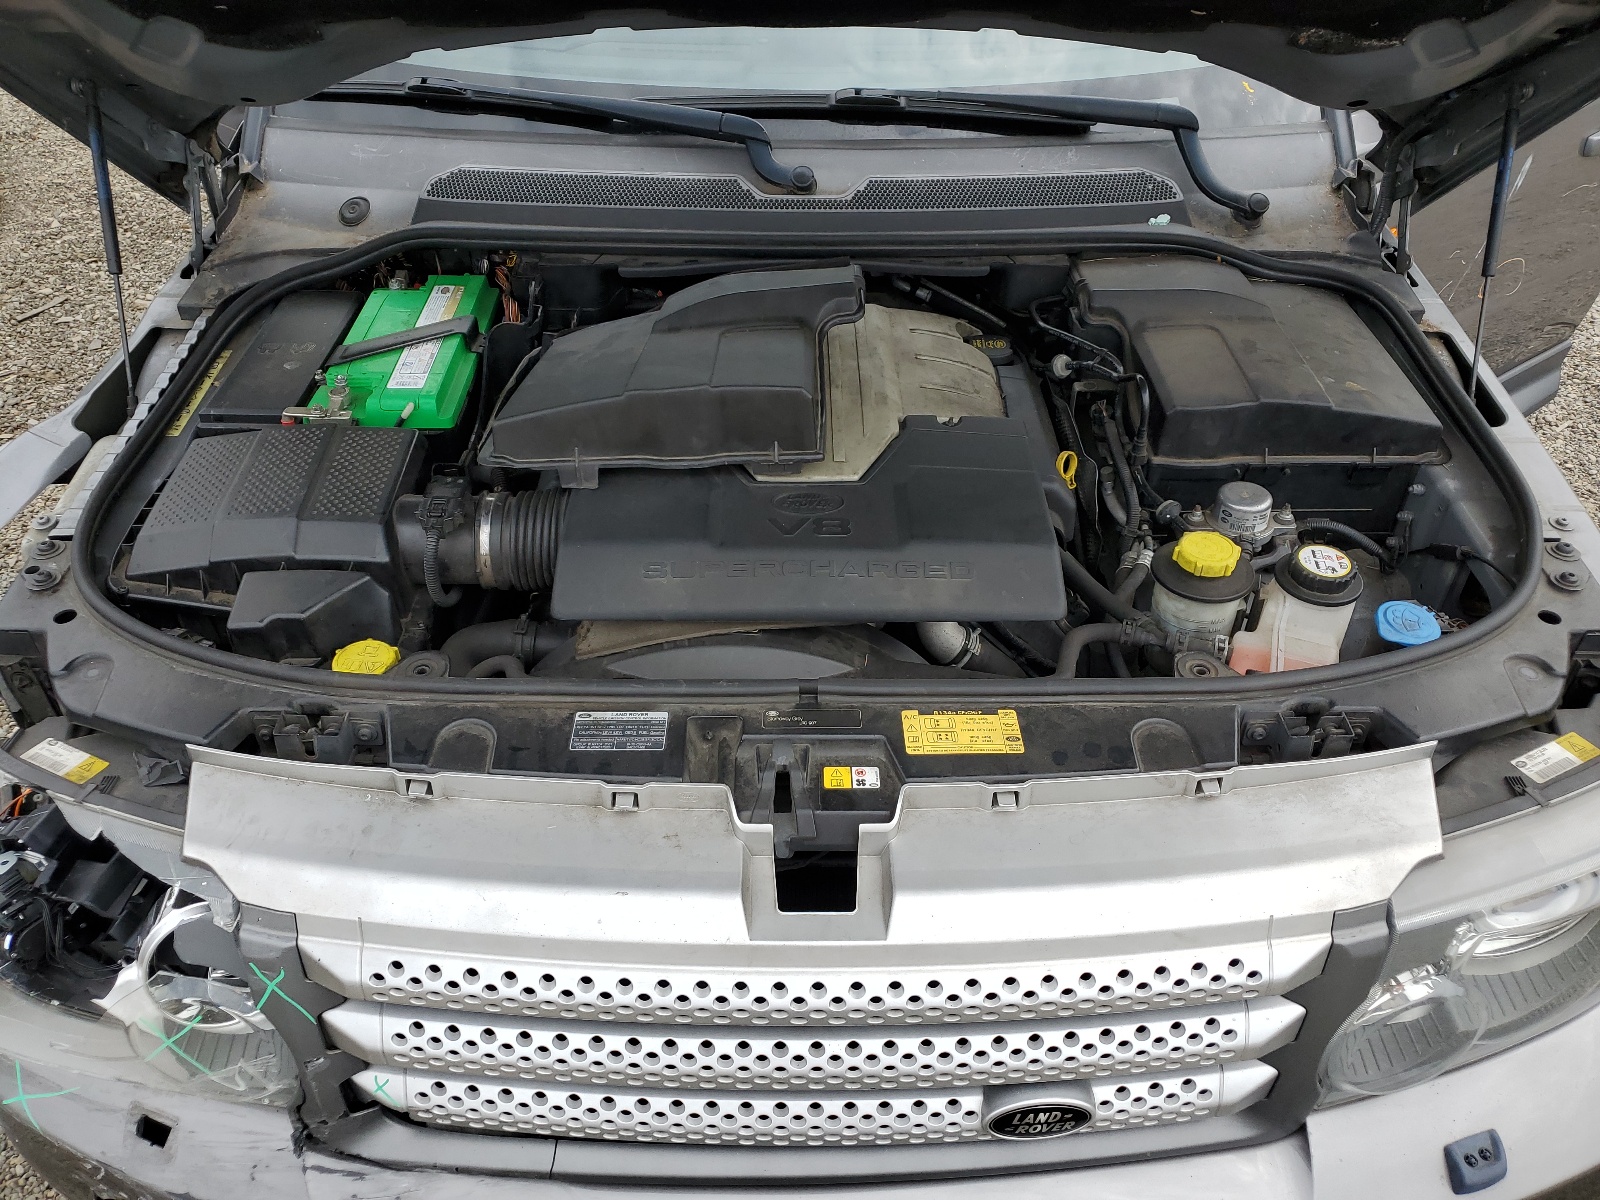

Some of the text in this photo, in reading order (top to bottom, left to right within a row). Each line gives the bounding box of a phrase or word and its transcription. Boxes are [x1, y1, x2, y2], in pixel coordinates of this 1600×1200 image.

[767, 517, 852, 537] V8
[642, 559, 975, 580] SUPERCHARGED
[1011, 1112, 1062, 1125] LAND
[1014, 1121, 1076, 1134] ROVER
